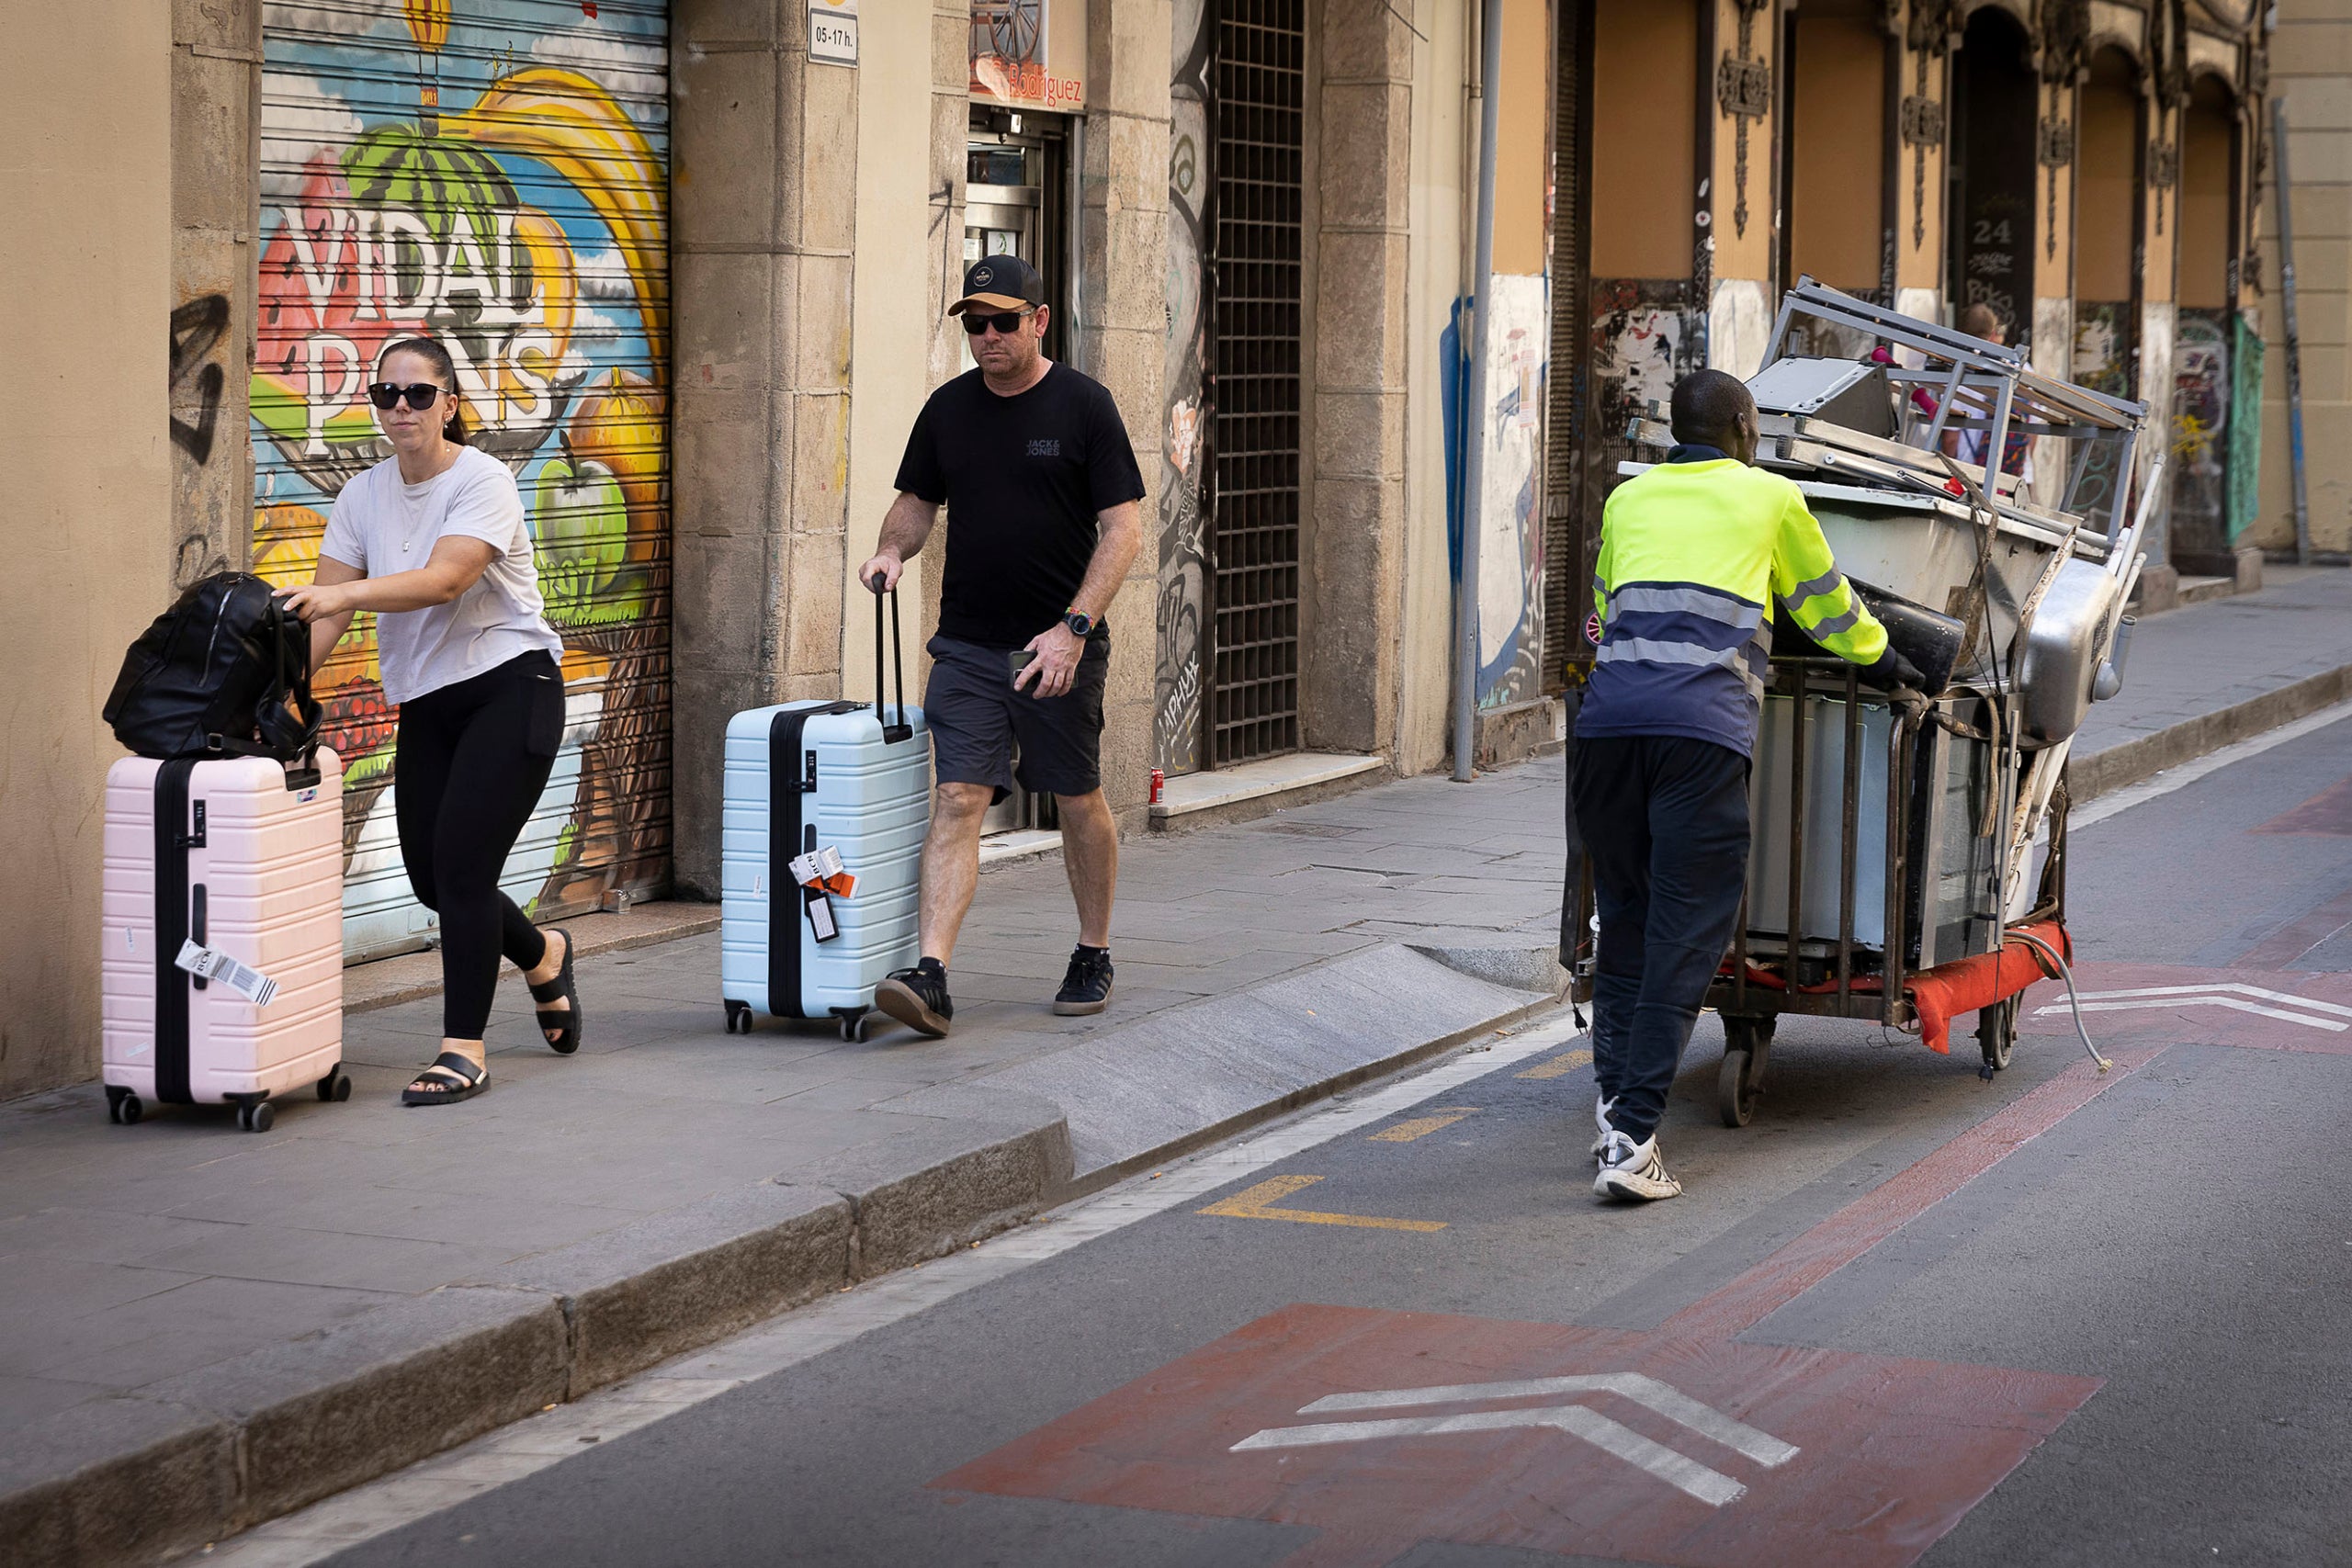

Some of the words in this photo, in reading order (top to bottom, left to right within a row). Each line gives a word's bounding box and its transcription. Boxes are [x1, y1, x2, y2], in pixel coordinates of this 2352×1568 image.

[1009, 63, 1082, 107] Rodríguez
[1973, 219, 2012, 244] 24
[279, 204, 545, 327] VIDAL
[1026, 447, 1060, 457] JONES
[807, 855, 820, 874] BCN
[197, 951, 211, 971] BCN
